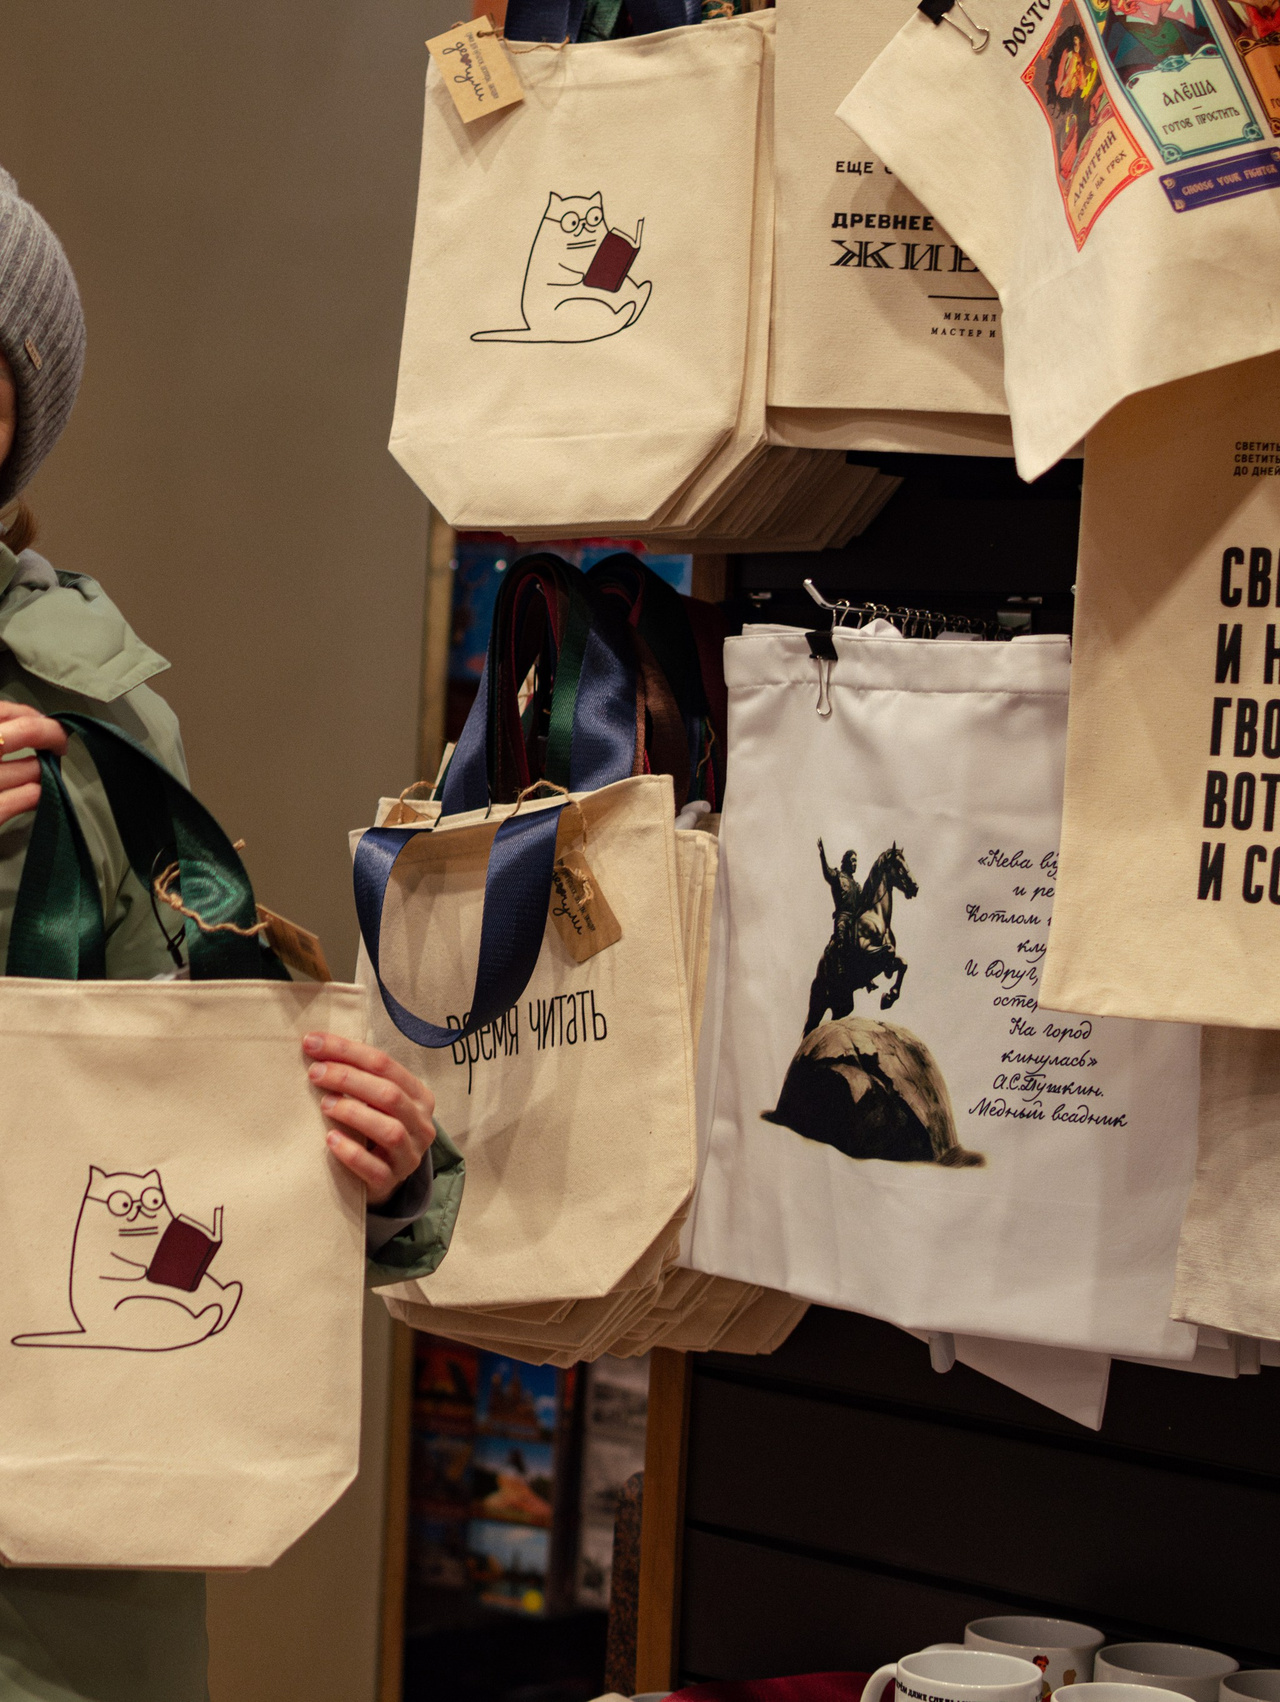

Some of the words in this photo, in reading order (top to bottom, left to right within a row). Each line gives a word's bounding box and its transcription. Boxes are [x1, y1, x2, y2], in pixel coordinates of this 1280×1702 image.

[1162, 79, 1217, 107] АЛЁША
[1162, 117, 1194, 135] ГОТОВ
[1195, 106, 1241, 126] ПРОСТИТЬ
[835, 160, 874, 176] ЕЩЕ
[1074, 130, 1117, 206] ДМИТРИЙ
[1181, 178, 1215, 197] CHOOSE
[1216, 172, 1243, 187] YOUR
[1243, 163, 1279, 180] FIGHTER
[1094, 175, 1105, 190] НА
[831, 212, 935, 231] ДРЕВНЕЕ
[943, 311, 997, 322] МИХАИЛ
[930, 327, 982, 338] МАСТЕР
[989, 329, 997, 338] И
[1234, 453, 1280, 464] СВЕТИТЬ
[1235, 441, 1280, 452] СВЕТИТЬ
[1232, 465, 1248, 477] ДО
[1221, 546, 1280, 608] СВ
[1215, 623, 1243, 684] И
[1202, 770, 1280, 832] ВОТ
[1197, 841, 1226, 901] И
[1012, 885, 1027, 896] и
[965, 903, 1042, 926] Котлом
[964, 958, 979, 977] И
[984, 959, 1039, 990] вдруг,
[1009, 1016, 1037, 1037] На
[1042, 1020, 1093, 1043] город
[1000, 1049, 1098, 1075] кинулась»
[968, 1097, 1046, 1121] Медный
[1051, 1103, 1128, 1128] всадник
